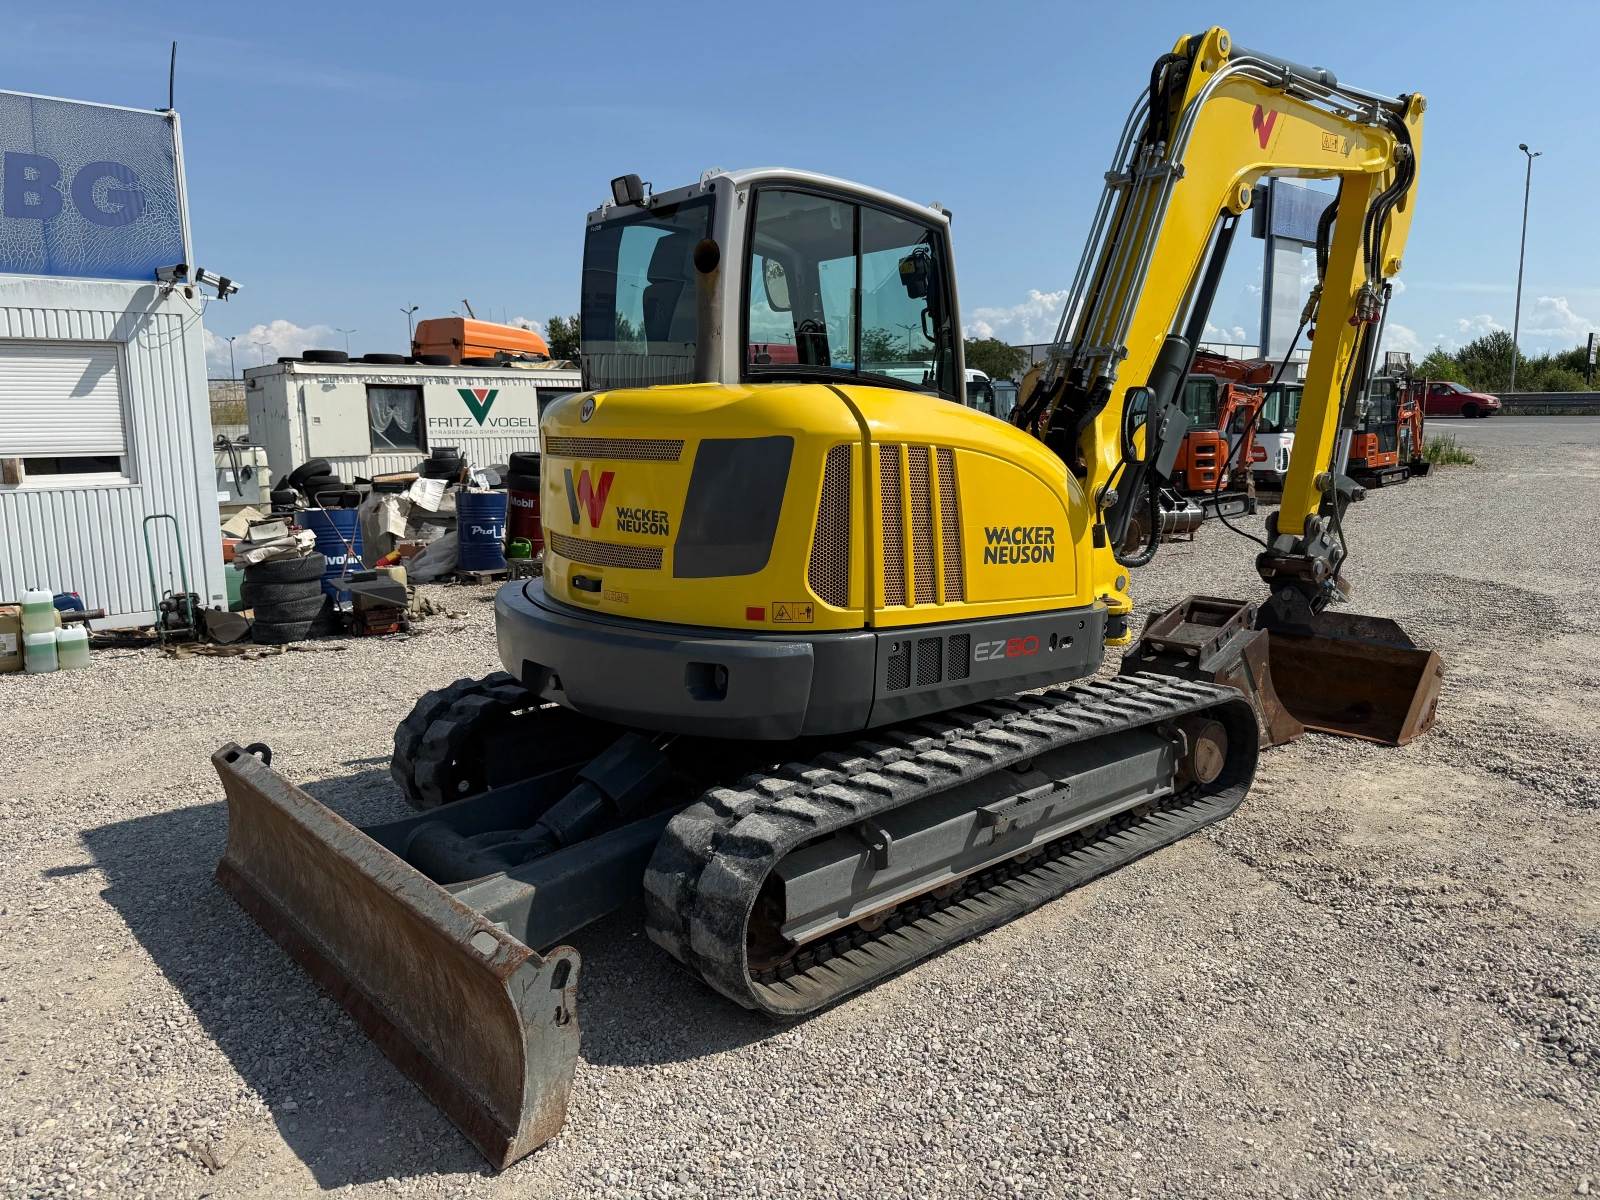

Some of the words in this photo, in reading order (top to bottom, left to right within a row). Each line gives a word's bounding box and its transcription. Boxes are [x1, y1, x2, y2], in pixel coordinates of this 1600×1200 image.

[429, 417, 473, 428] FRITZ
[488, 417, 537, 427] VOGEL
[511, 496, 534, 508] Mobil
[616, 506, 669, 524] WACKER
[617, 519, 669, 536] NEUSON
[984, 526, 1055, 545] WACKER
[983, 545, 1055, 565] NEUSON
[974, 636, 1040, 661] EZ80
